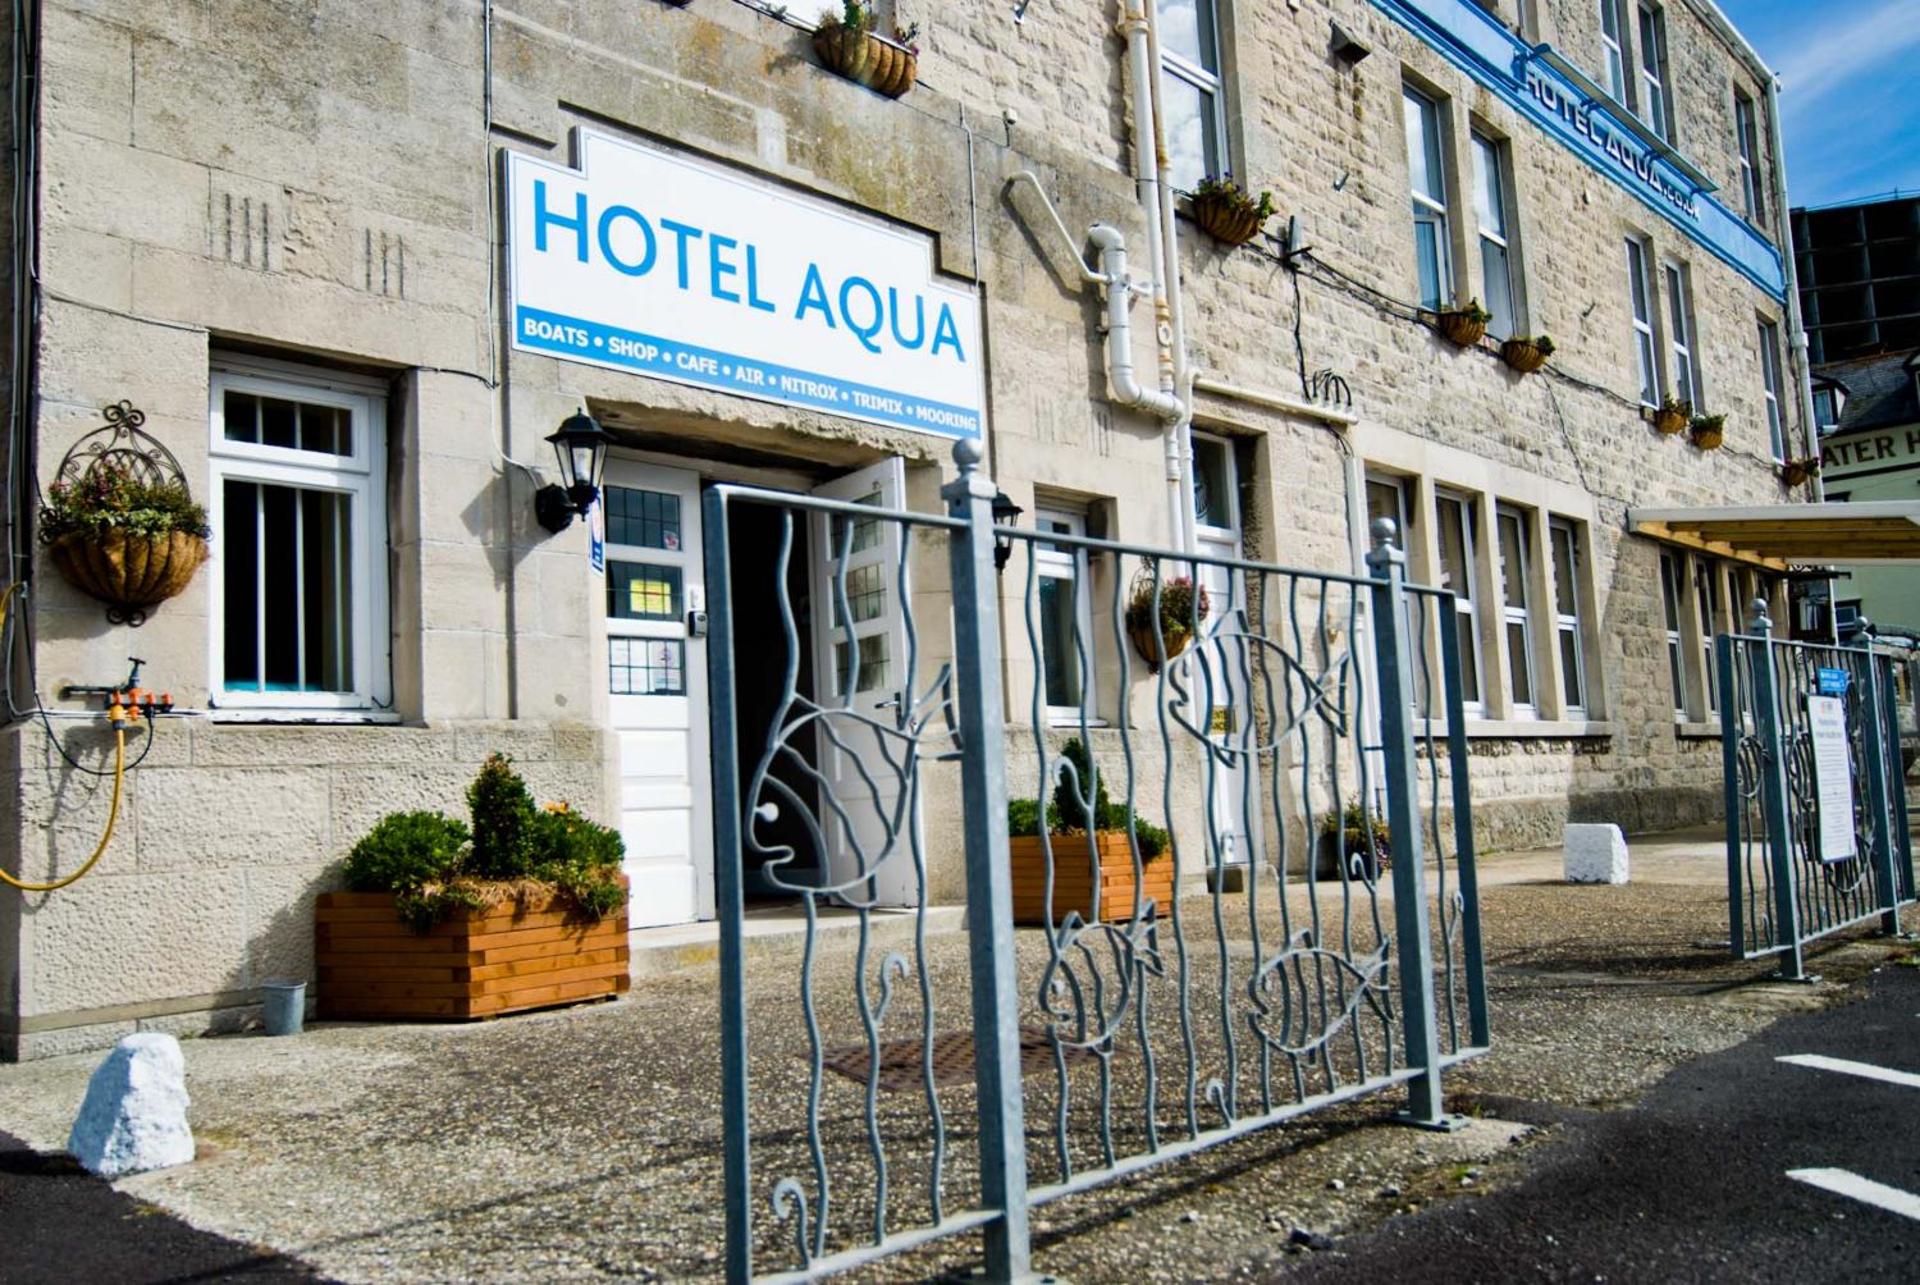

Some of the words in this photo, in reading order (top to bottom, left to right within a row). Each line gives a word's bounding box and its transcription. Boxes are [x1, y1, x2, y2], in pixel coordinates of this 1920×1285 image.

[534, 179, 776, 313] HOTEL
[795, 262, 967, 362] AQUA
[524, 318, 589, 347] BOATS
[608, 336, 658, 361] SHOP
[676, 352, 718, 376] CAFE
[735, 365, 765, 386] AIR
[781, 375, 838, 401] NITROX
[852, 390, 903, 416] TRIMIX
[916, 405, 977, 431] MOORING
